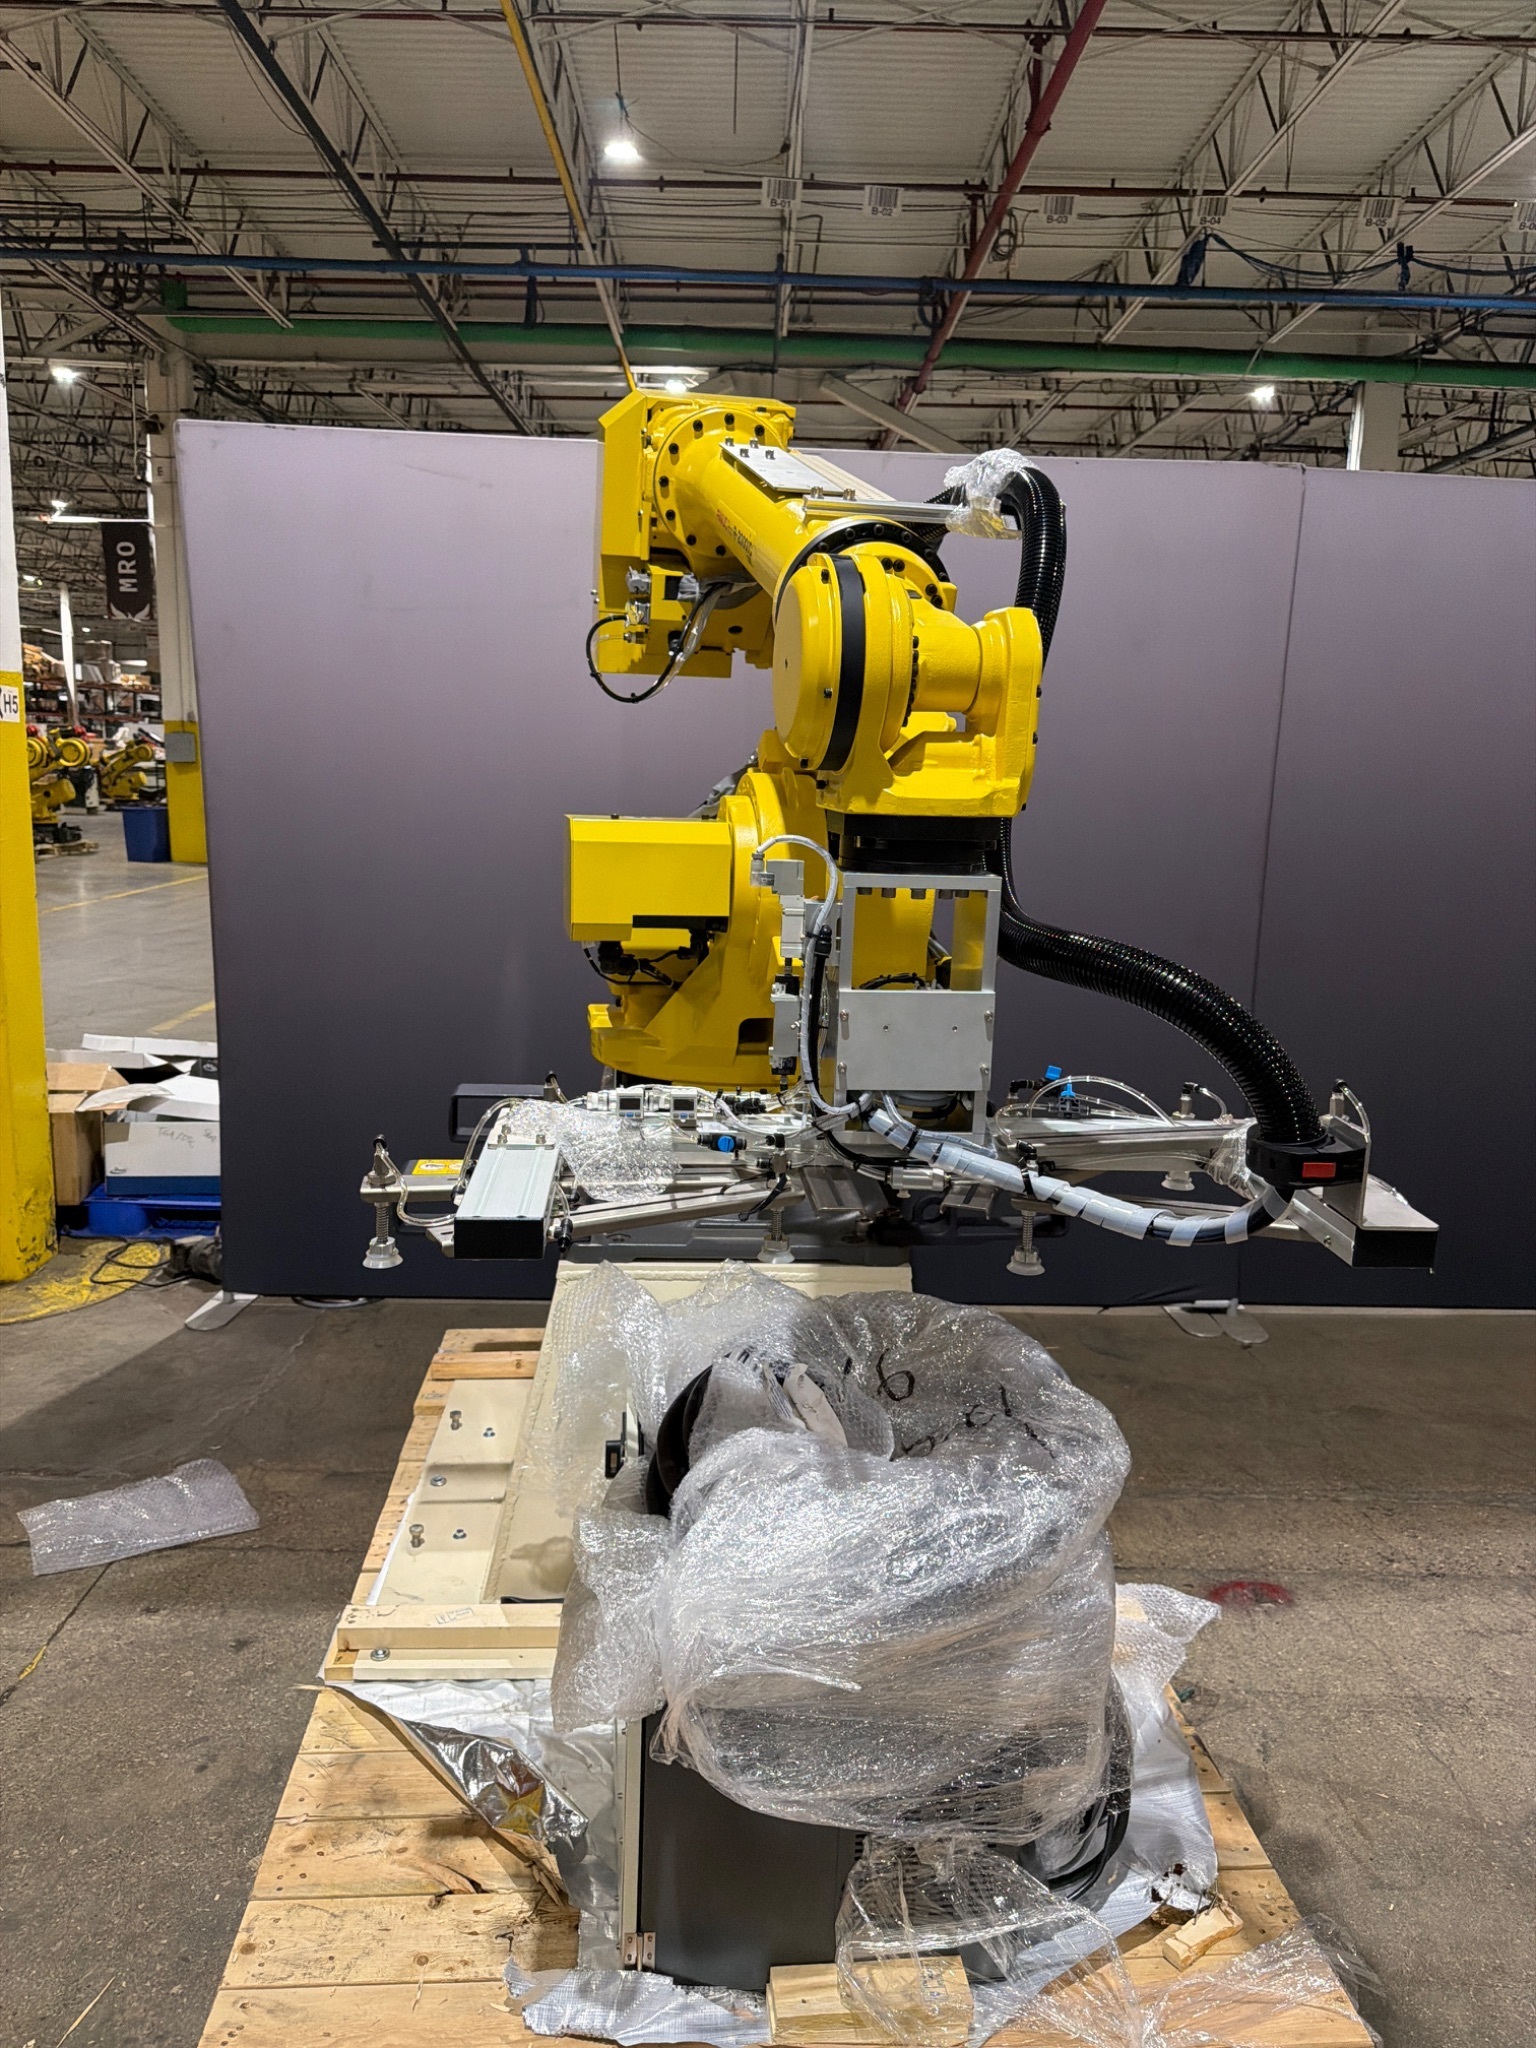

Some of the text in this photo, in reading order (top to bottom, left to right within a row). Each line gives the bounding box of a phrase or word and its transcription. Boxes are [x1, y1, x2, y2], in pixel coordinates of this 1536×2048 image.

[769, 199, 791, 208] B-01
[871, 207, 893, 216] B-02
[1046, 215, 1069, 224] B-03
[1200, 216, 1222, 225] B-04
[1365, 218, 1387, 227] B-05
[1518, 221, 1536, 231] B-0
[116, 541, 139, 593] MRO
[3, 693, 19, 714] H5
